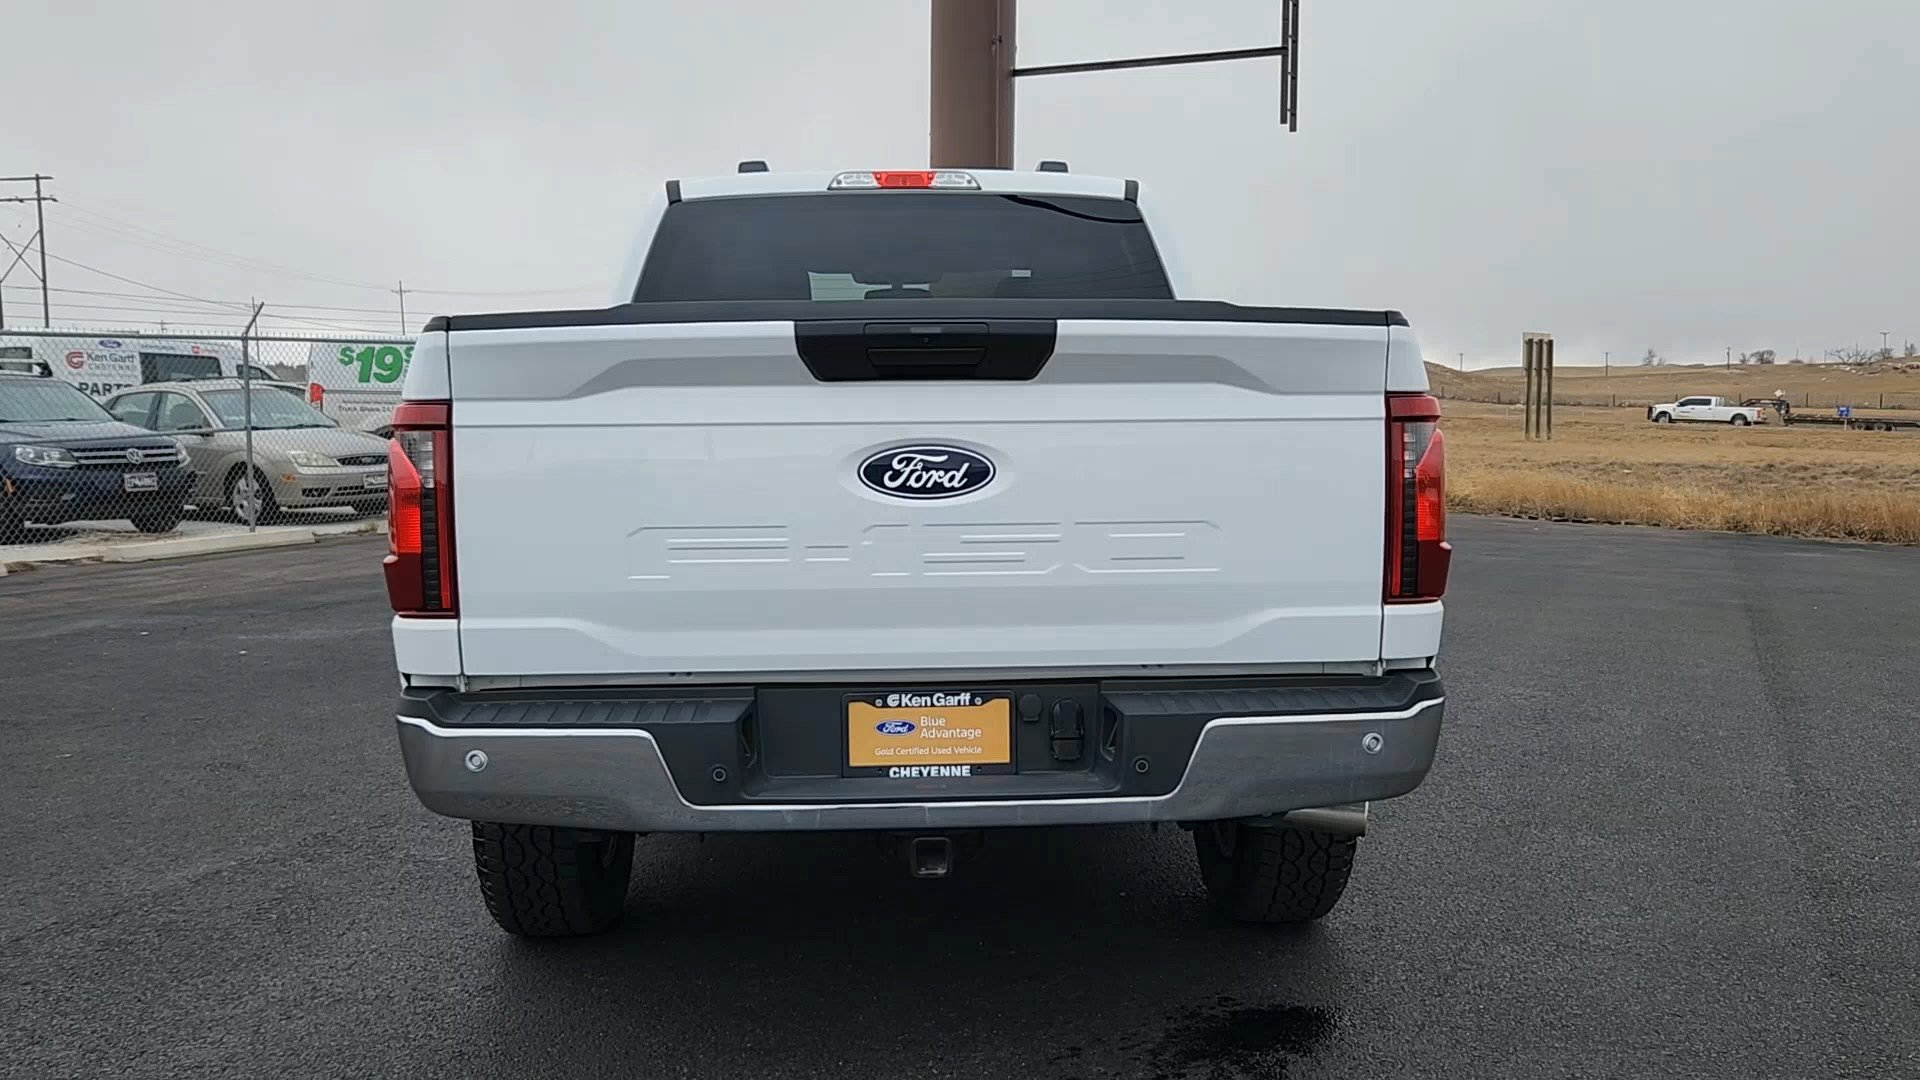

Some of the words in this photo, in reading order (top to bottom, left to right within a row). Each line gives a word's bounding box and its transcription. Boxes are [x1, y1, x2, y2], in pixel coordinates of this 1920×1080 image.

[86, 351, 107, 361] Ken
[79, 382, 134, 396] PART
[883, 453, 970, 488] Ford
[901, 693, 931, 707] Ken
[933, 693, 971, 706] Garff
[920, 716, 946, 726] Blue
[882, 722, 909, 733] Ford
[920, 728, 982, 739] Advantage
[874, 748, 894, 756] Gold
[895, 747, 929, 755] Certified
[931, 746, 952, 755] Used
[953, 746, 982, 754] Vehicle
[889, 765, 971, 778] CHEYENNE
